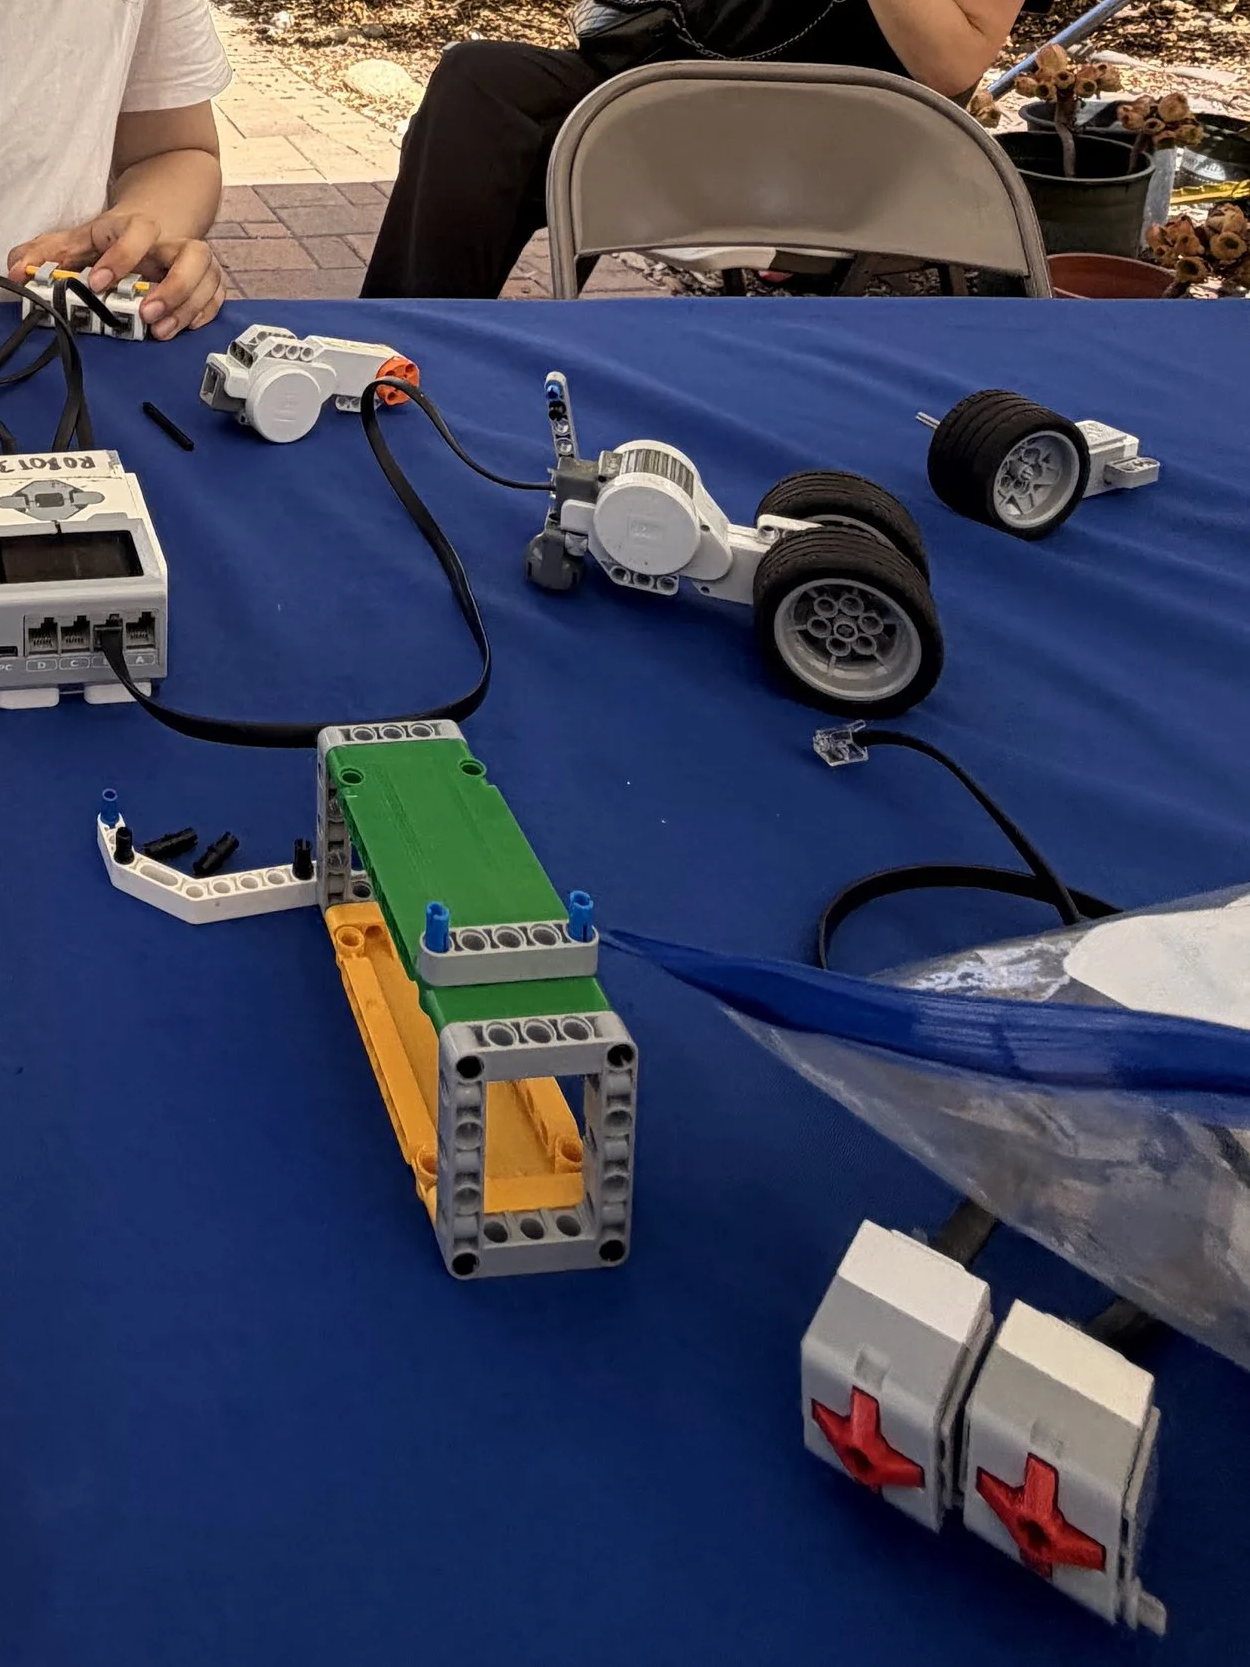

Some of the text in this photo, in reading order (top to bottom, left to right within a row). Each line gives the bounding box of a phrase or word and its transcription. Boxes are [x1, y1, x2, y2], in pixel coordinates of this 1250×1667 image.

[18, 455, 97, 471] ROBOT
[70, 659, 79, 668] C
[135, 655, 145, 664] A
[37, 661, 47, 670] D
